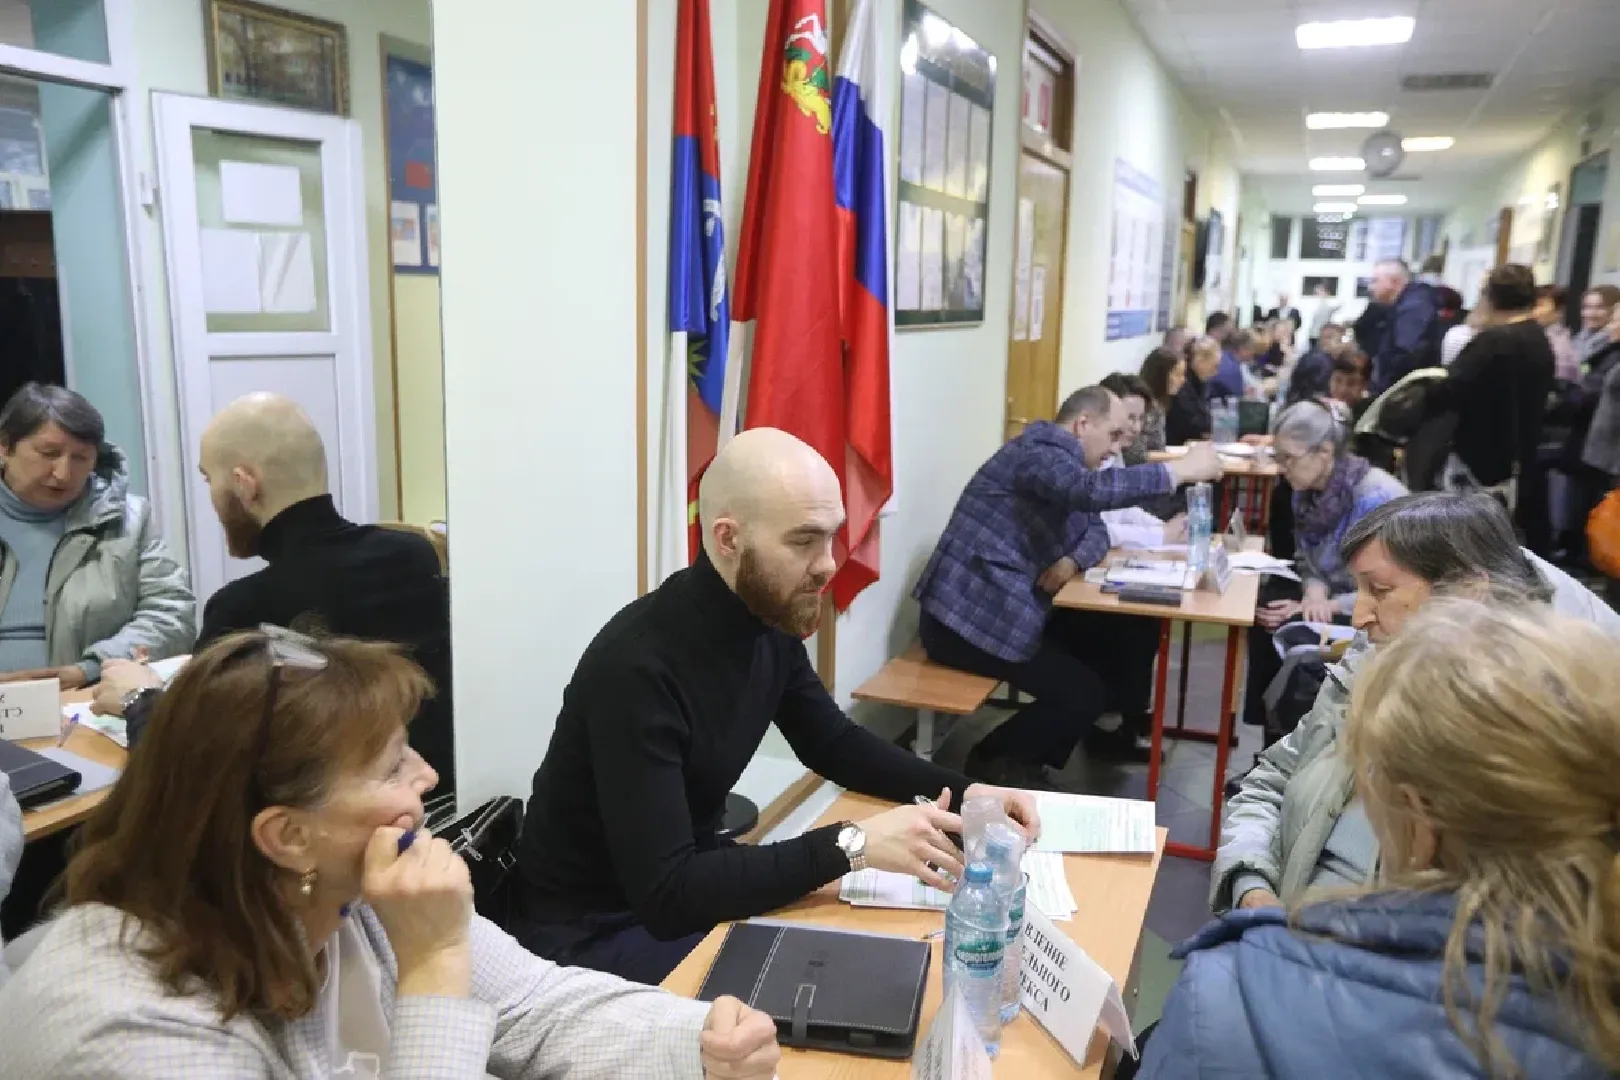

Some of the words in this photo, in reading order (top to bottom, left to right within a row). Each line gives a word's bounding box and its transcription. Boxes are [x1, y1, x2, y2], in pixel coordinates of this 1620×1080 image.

[1024, 921, 1068, 972] ВЛЕНИЕ
[1020, 970, 1048, 1012] ЕКСА
[1021, 944, 1071, 1003] ЕЛЬНОГО
